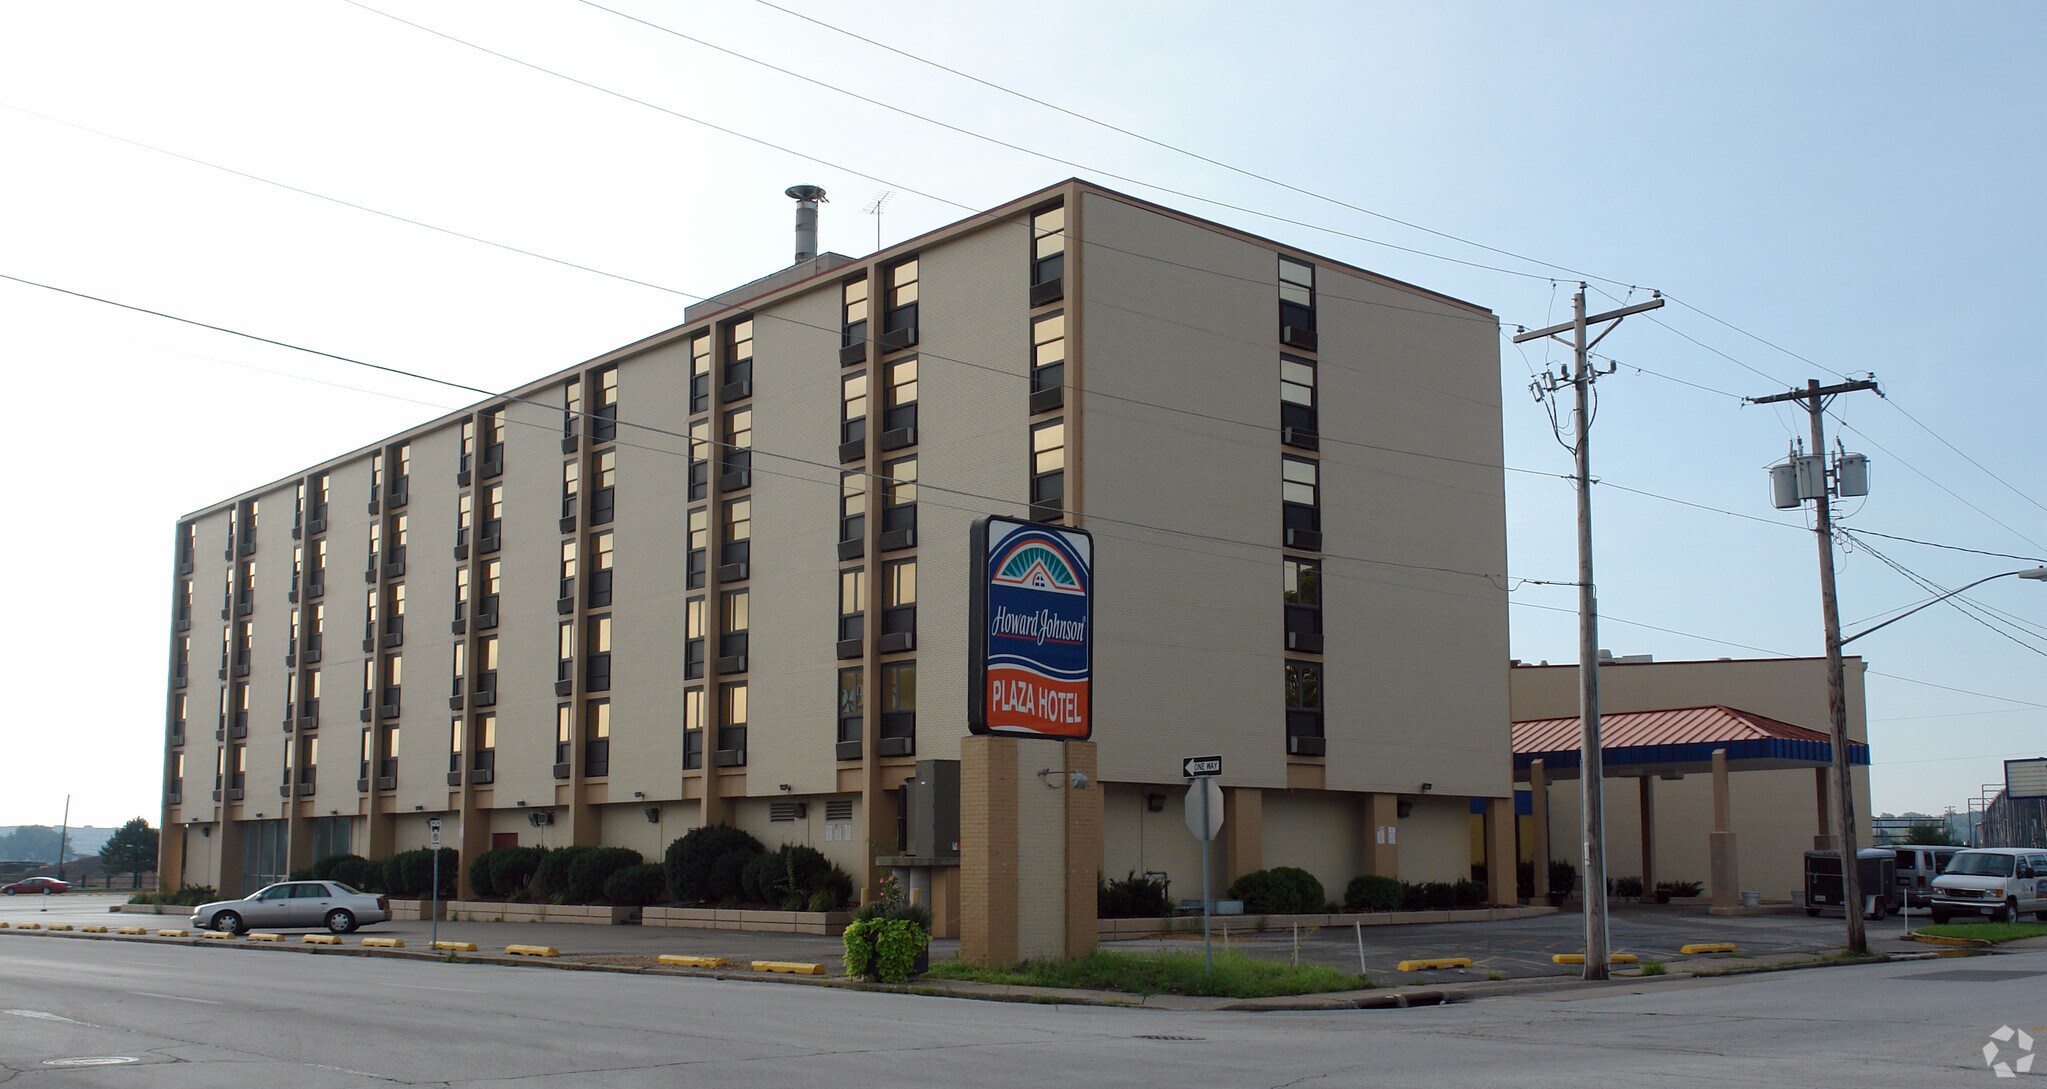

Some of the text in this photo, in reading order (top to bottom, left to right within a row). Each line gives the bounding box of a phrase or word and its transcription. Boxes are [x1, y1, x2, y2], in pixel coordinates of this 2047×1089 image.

[992, 605, 1085, 646] Howard Johnson
[992, 679, 1082, 724] PLAZA HOTEL
[1194, 761, 1218, 771] ONE WAY
